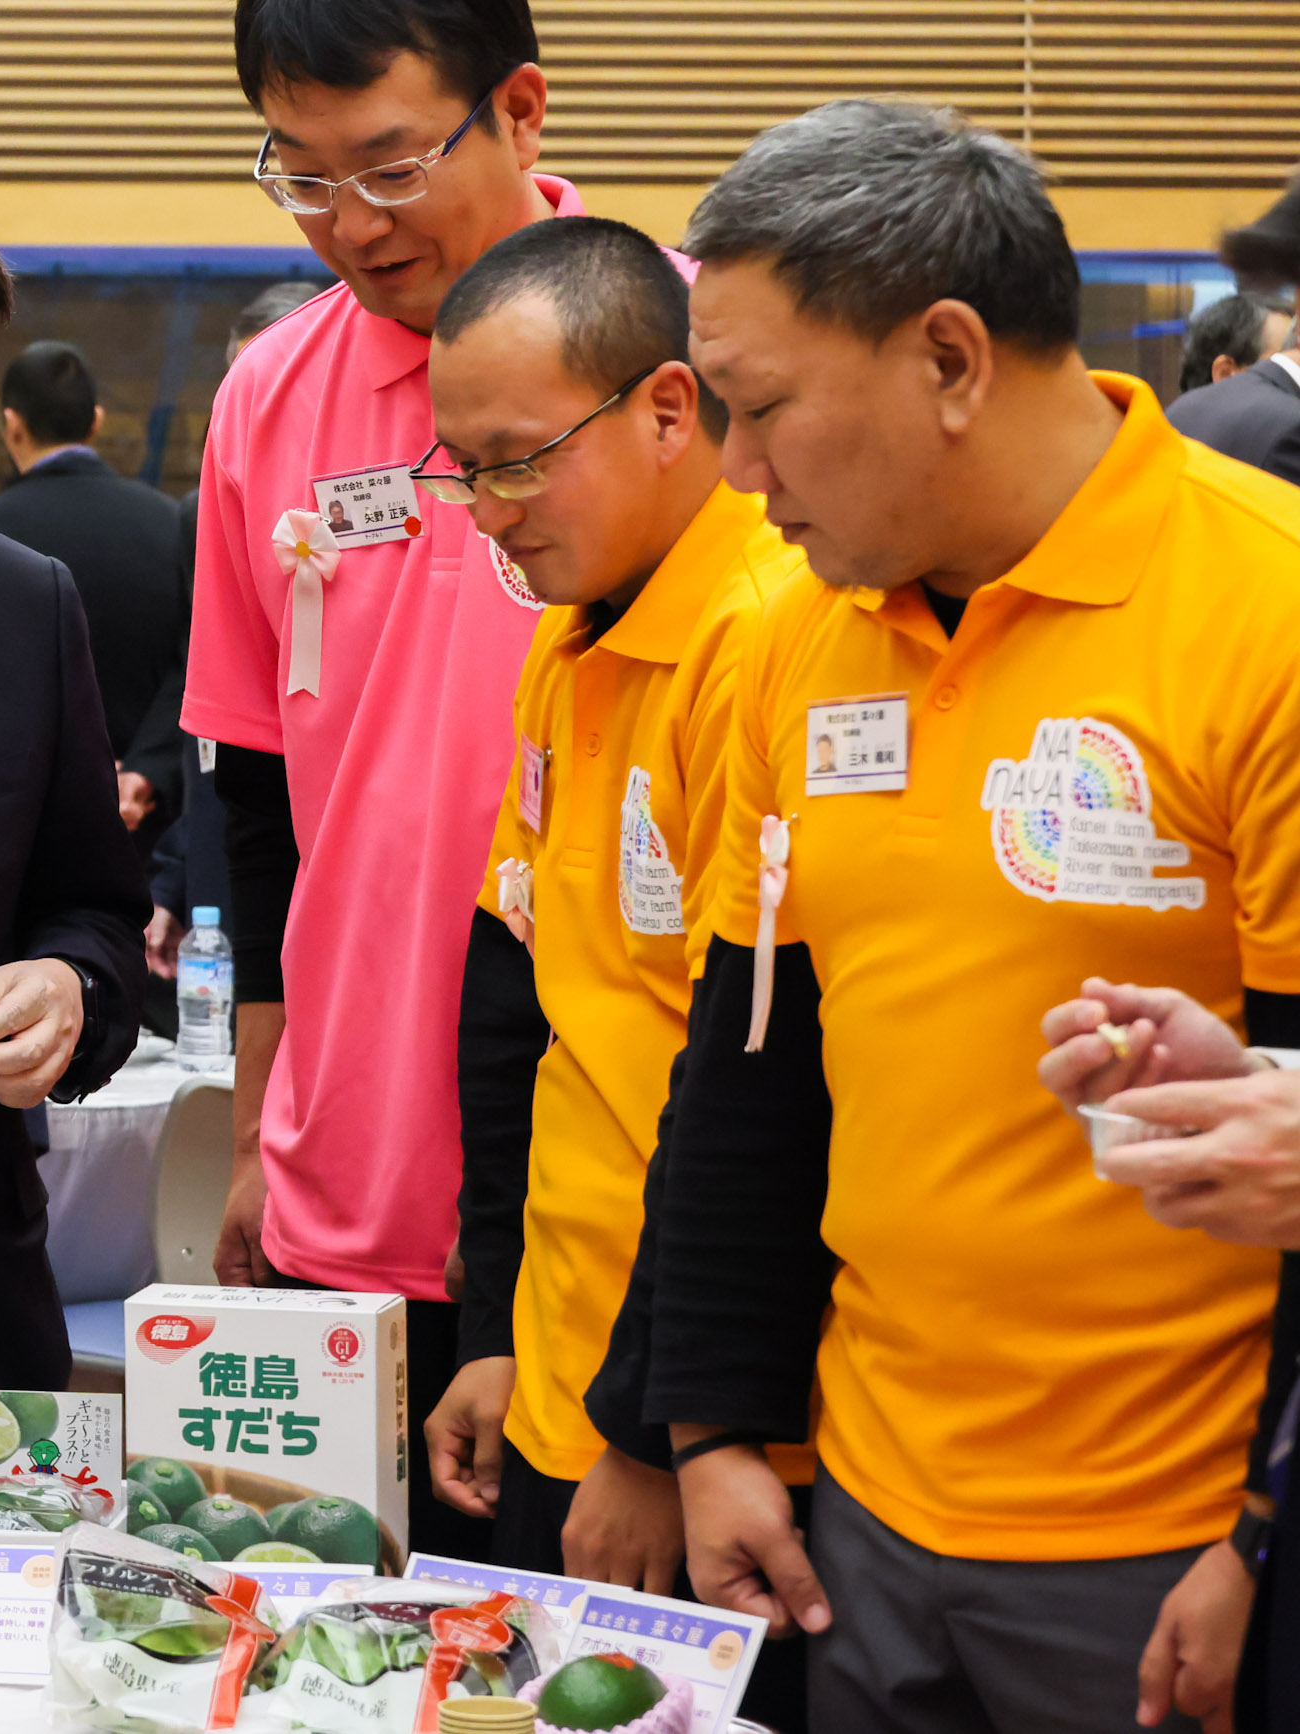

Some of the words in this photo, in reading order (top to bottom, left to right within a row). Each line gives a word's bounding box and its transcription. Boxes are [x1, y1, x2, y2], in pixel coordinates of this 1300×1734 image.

[1035, 727, 1071, 763] NA
[335, 1340, 350, 1355] GI
[199, 1352, 299, 1400] 徳島
[178, 1407, 320, 1456] すだち
[586, 1610, 641, 1632] 株式会社
[650, 1618, 705, 1645] 菜々屋
